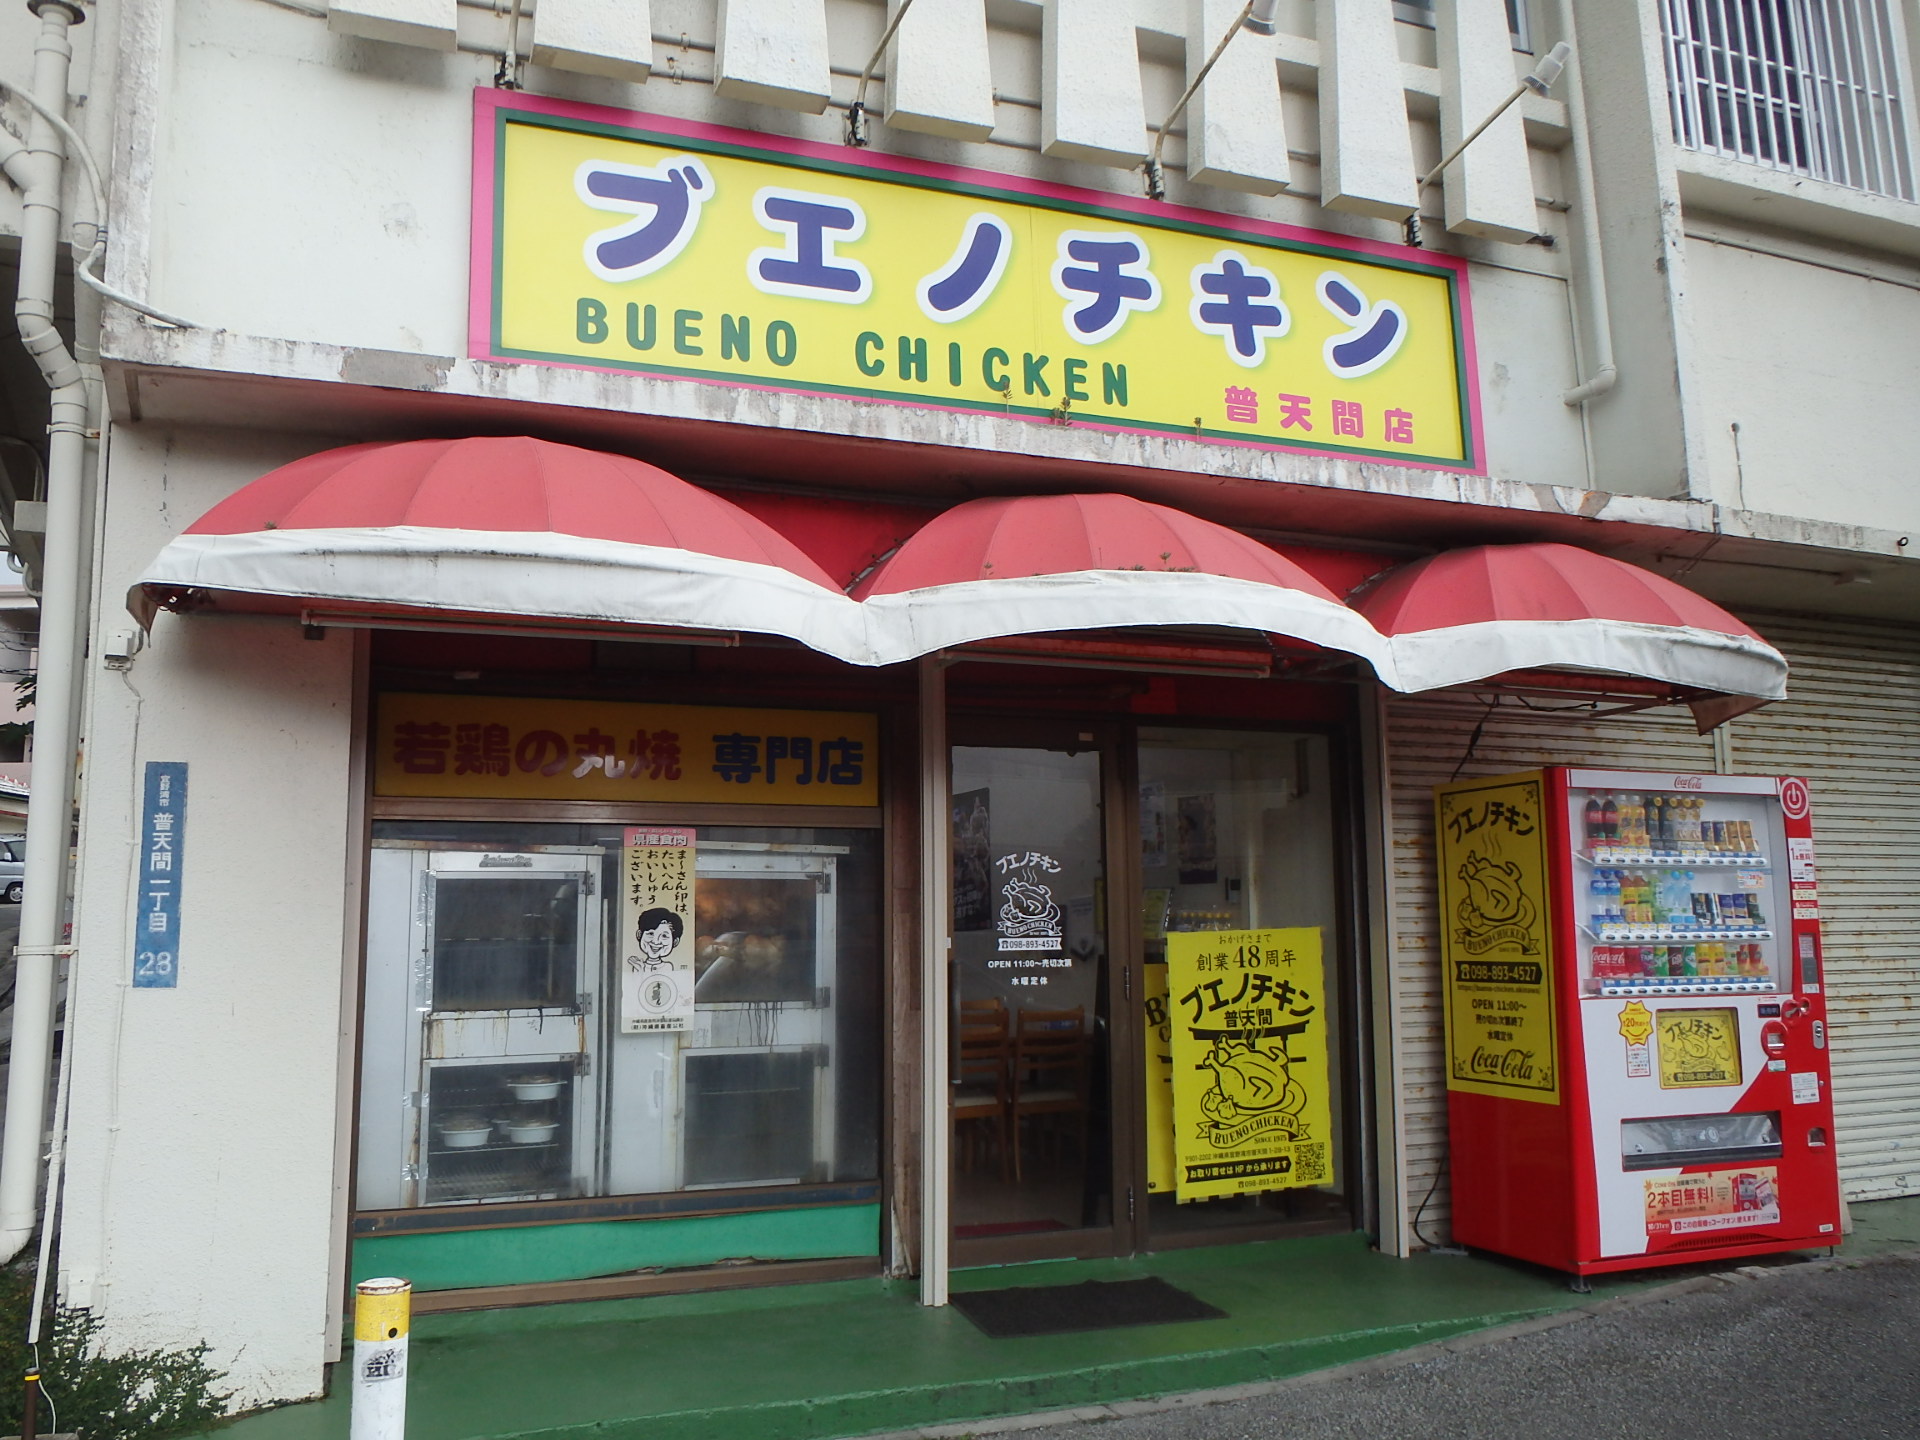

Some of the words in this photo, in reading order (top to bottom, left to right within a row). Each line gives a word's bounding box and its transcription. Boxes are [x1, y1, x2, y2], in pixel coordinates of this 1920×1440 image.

[580, 158, 1402, 372] ブエノチキン
[575, 296, 799, 367] BUENO
[855, 330, 1130, 408] CHICKEN
[1223, 384, 1416, 444] 普天間店
[393, 720, 682, 780] 若鶏の丸焼
[711, 732, 864, 785] 専門店
[1674, 775, 1701, 789] Coca-Cola
[632, 834, 688, 847] 県産食肉
[148, 812, 175, 933] 普天間一丁目
[661, 849, 674, 891] たいへん
[995, 851, 1062, 874] ブエノチキン
[630, 849, 644, 908] ございます。
[646, 849, 659, 905] おいしゅう
[1009, 940, 1059, 949] 098-893-4527
[1218, 933, 1273, 945] おかげさまで
[1466, 934, 1493, 952] BUENO
[1492, 927, 1528, 943] CHICKEN
[988, 960, 1011, 969] OPEN
[1196, 944, 1297, 972] 創業48周年
[1470, 965, 1537, 982] 098-893-4527
[1180, 972, 1316, 1024] ブエノチキン
[1472, 998, 1494, 1010] OPEN
[1223, 1008, 1273, 1028] 普天間
[1487, 1029, 1514, 1041] 水曜定休
[1213, 1124, 1250, 1145] BUENO
[1249, 1115, 1294, 1131] CHICKEN
[1648, 1186, 1714, 1208] 2本目無料!
